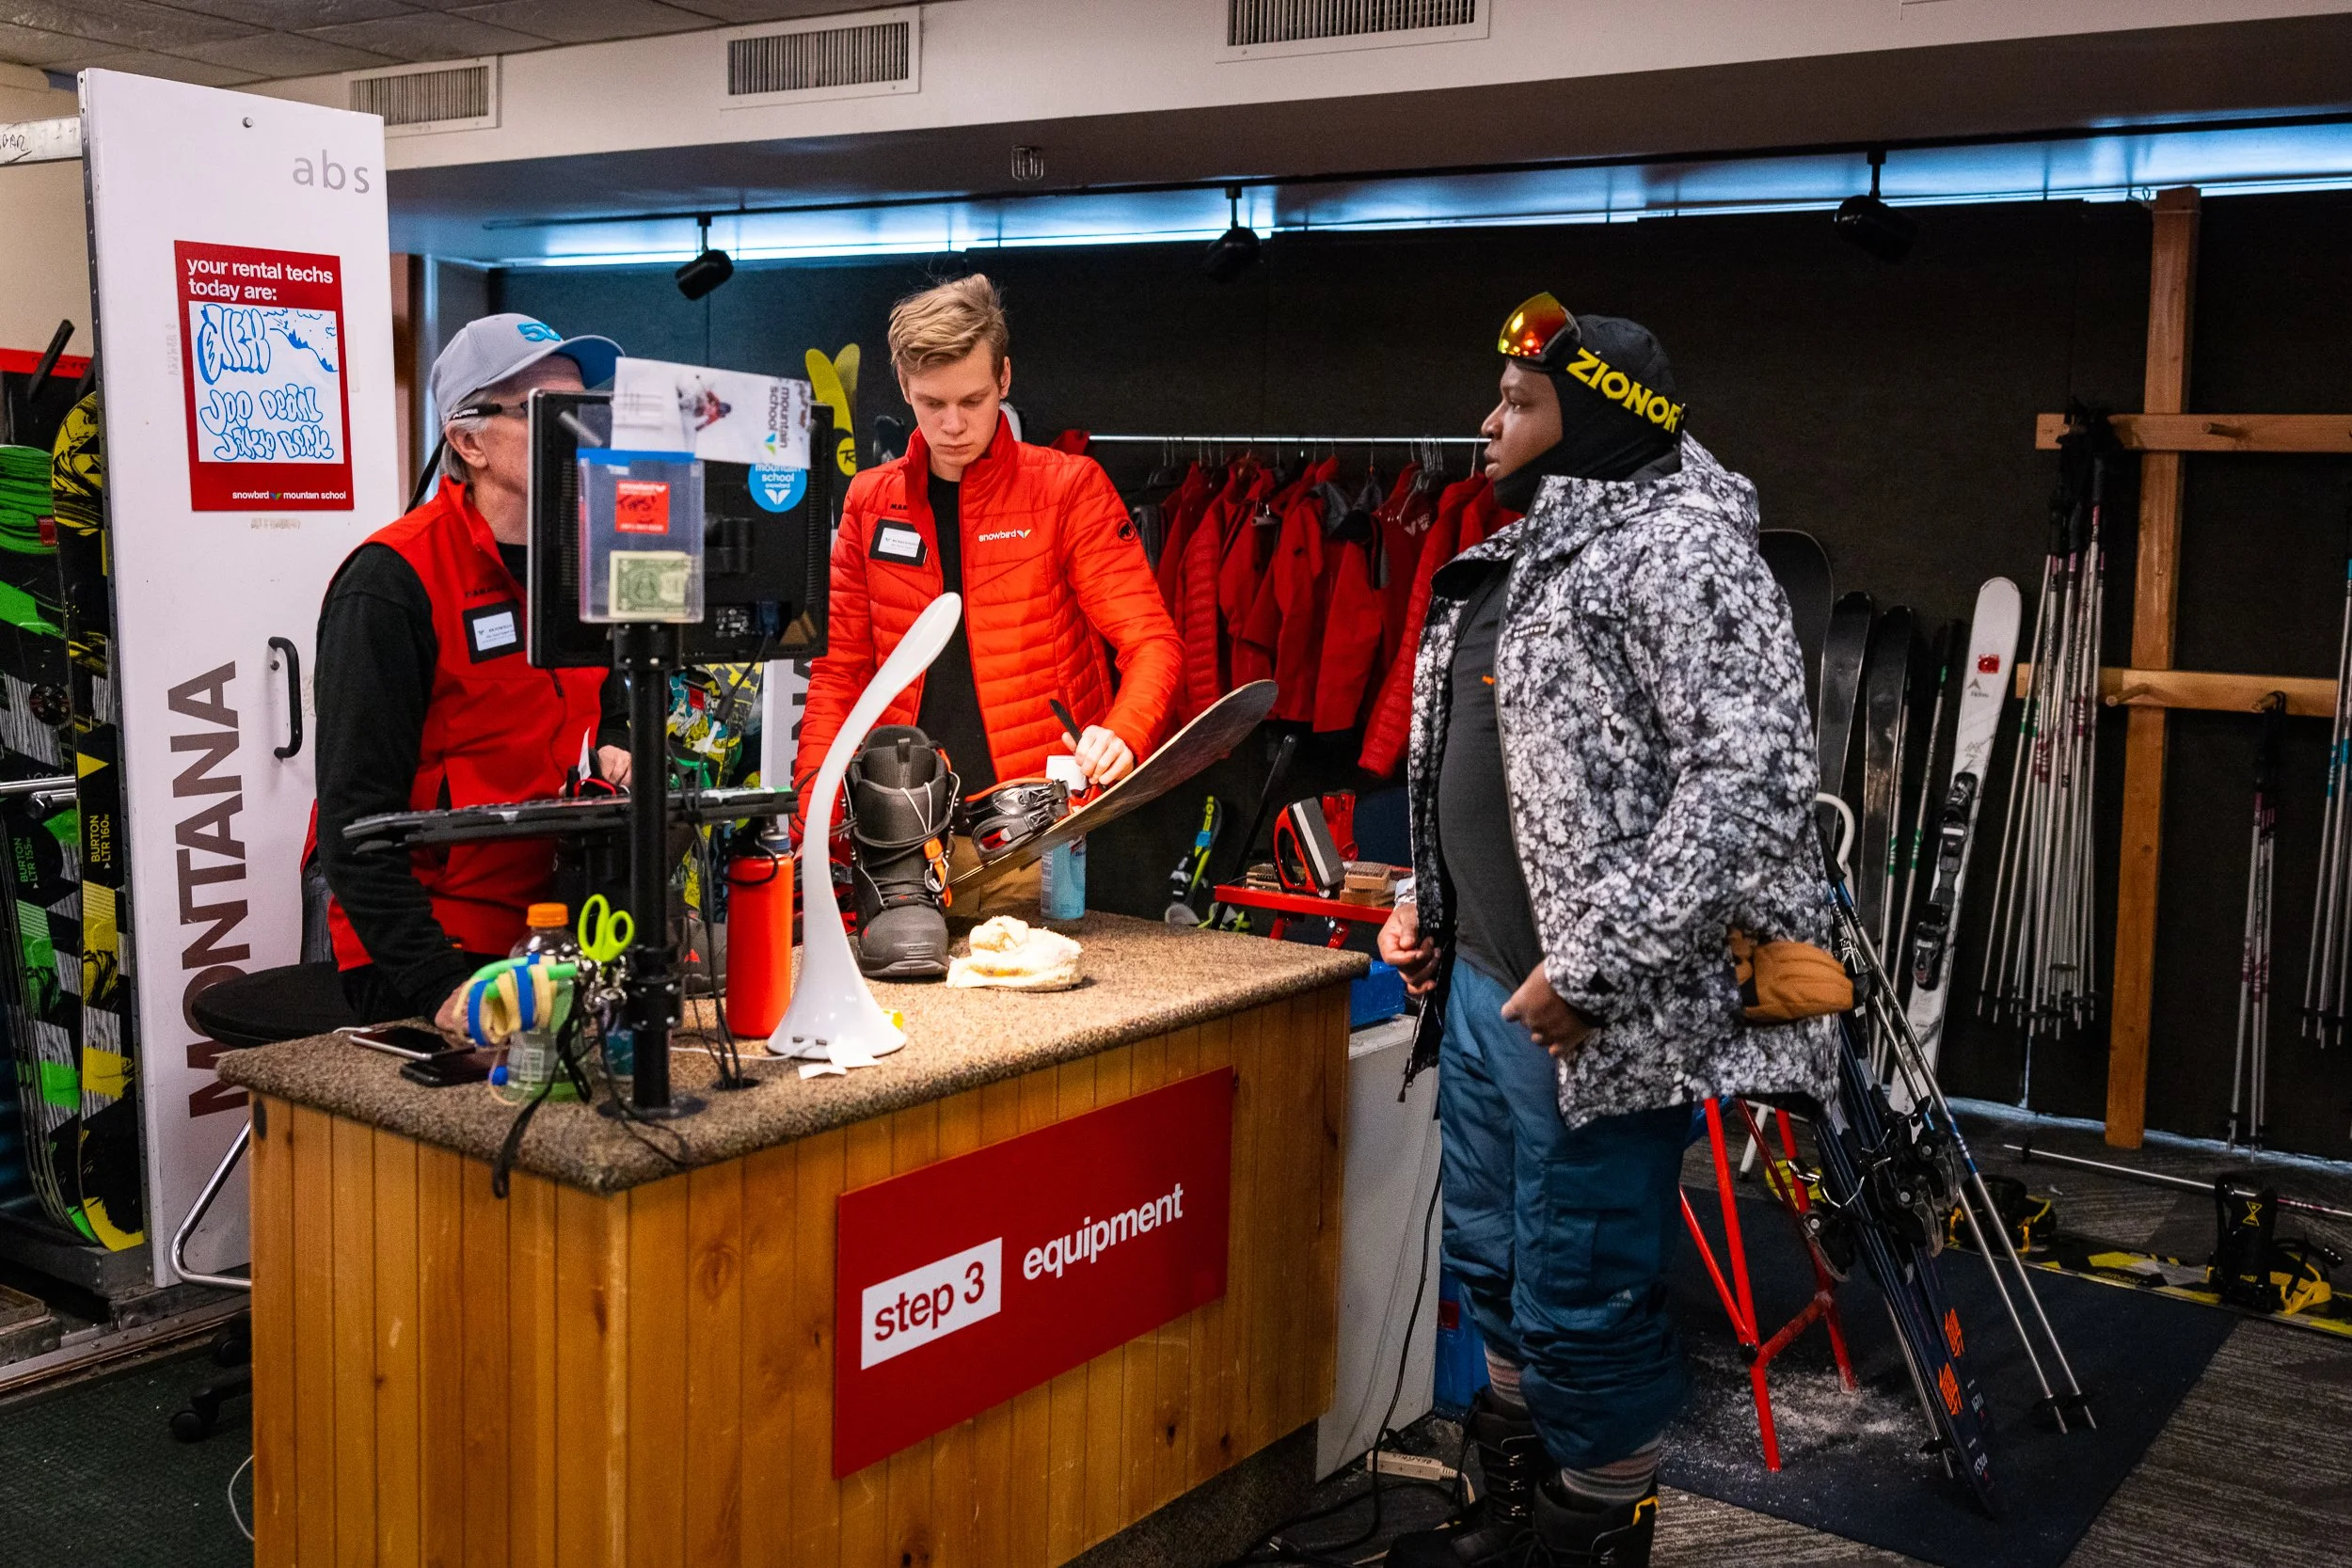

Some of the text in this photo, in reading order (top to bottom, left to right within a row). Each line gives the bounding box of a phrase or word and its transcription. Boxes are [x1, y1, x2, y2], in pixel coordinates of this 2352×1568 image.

[293, 149, 370, 194] abs
[186, 259, 333, 283] your rental techs
[189, 278, 277, 301] today are:
[1565, 347, 1683, 434] ZIONOR
[768, 386, 779, 431] school
[779, 386, 790, 449] mountain
[762, 472, 795, 482] school
[232, 490, 346, 499] snowbird mountain school
[978, 529, 1017, 543] snowbird
[89, 815, 101, 863] BURTON
[101, 842, 111, 862] LTR
[13, 837, 29, 882] BURTON
[27, 863, 39, 881] LTR
[874, 1182, 1184, 1342] step 3 equipment
